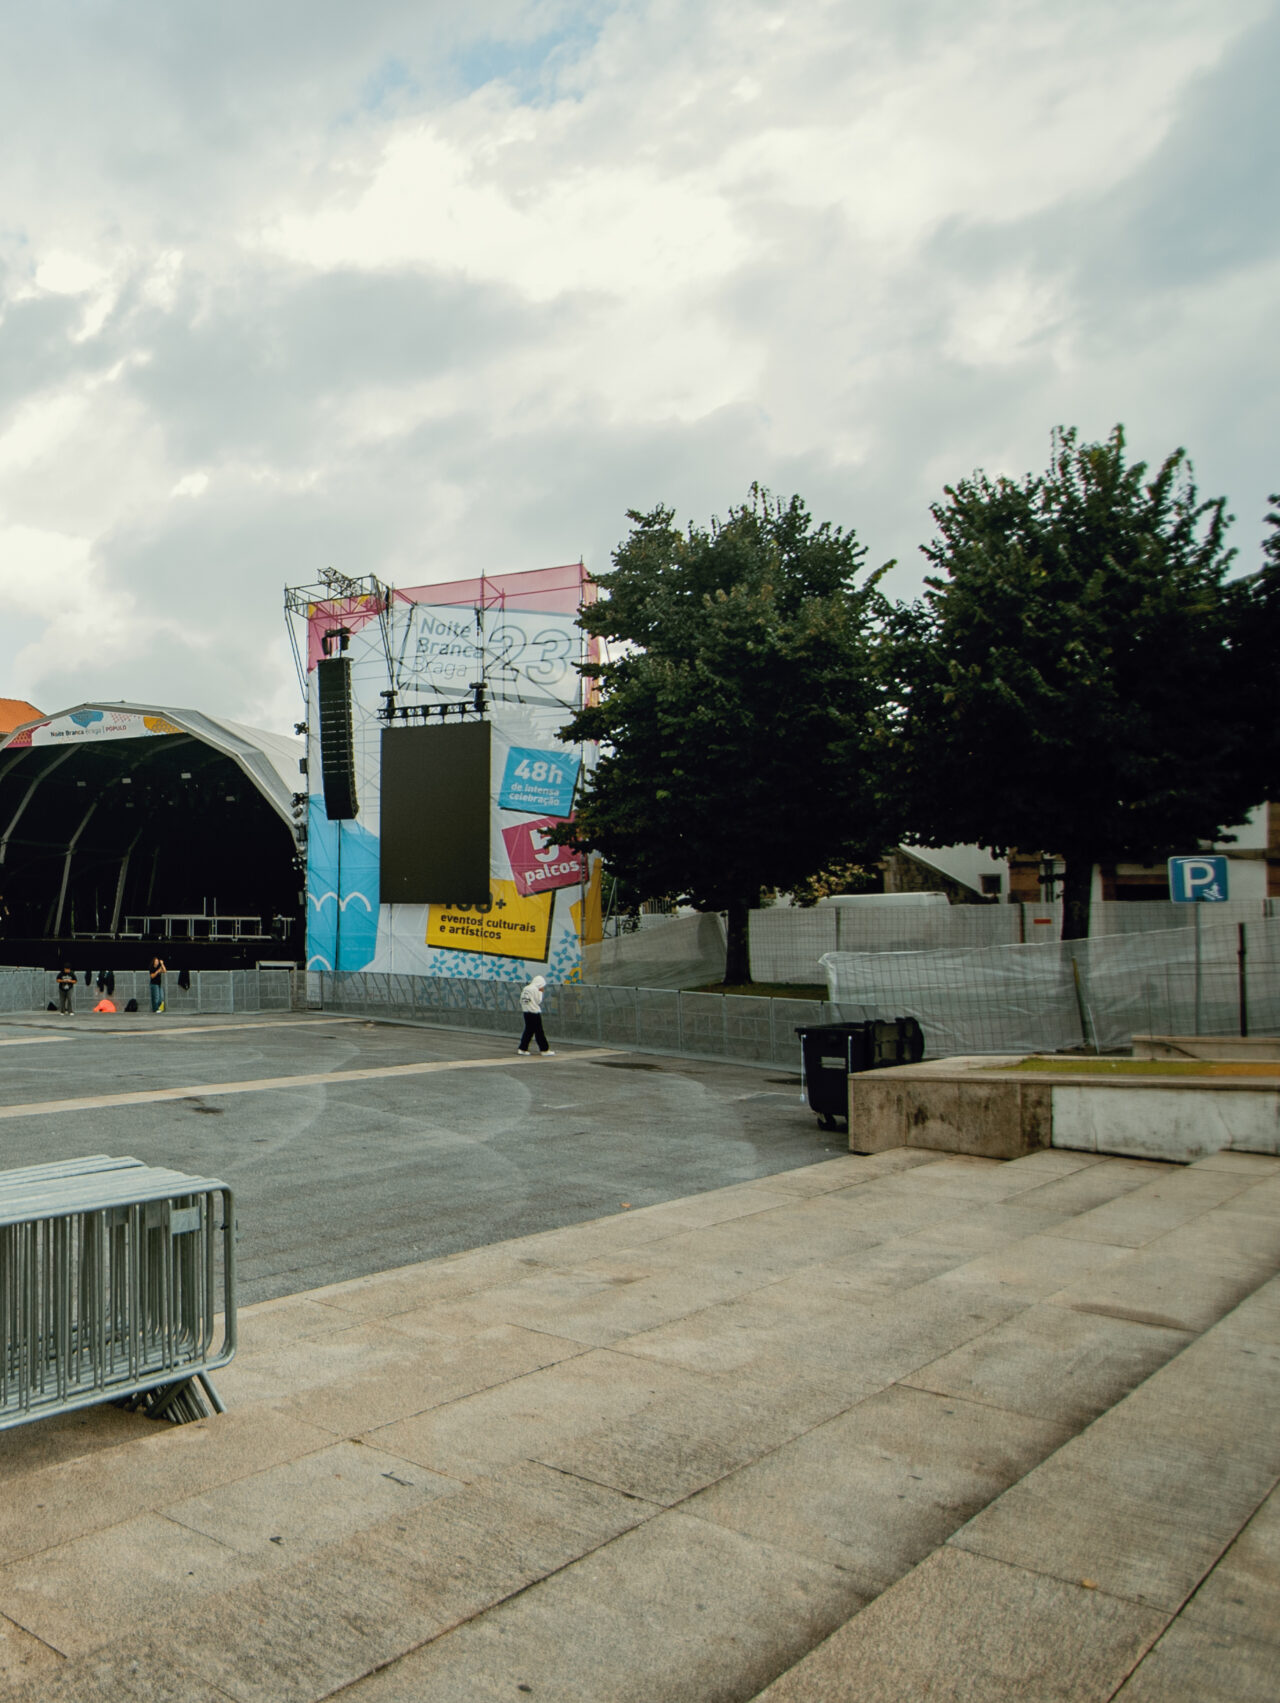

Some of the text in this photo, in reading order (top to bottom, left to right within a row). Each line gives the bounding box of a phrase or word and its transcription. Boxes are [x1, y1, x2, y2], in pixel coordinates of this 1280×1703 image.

[419, 617, 471, 638] Noite
[416, 637, 484, 659] Branca
[484, 625, 572, 686] 23
[412, 656, 467, 680] Braga
[513, 759, 564, 785] 48h
[508, 791, 560, 807] celebração
[511, 782, 559, 796] de intensa
[529, 826, 560, 863] 5
[524, 860, 580, 886] palcos
[1183, 861, 1215, 898] P
[439, 925, 502, 940] e artísticos
[440, 914, 536, 933] eventos culturais
